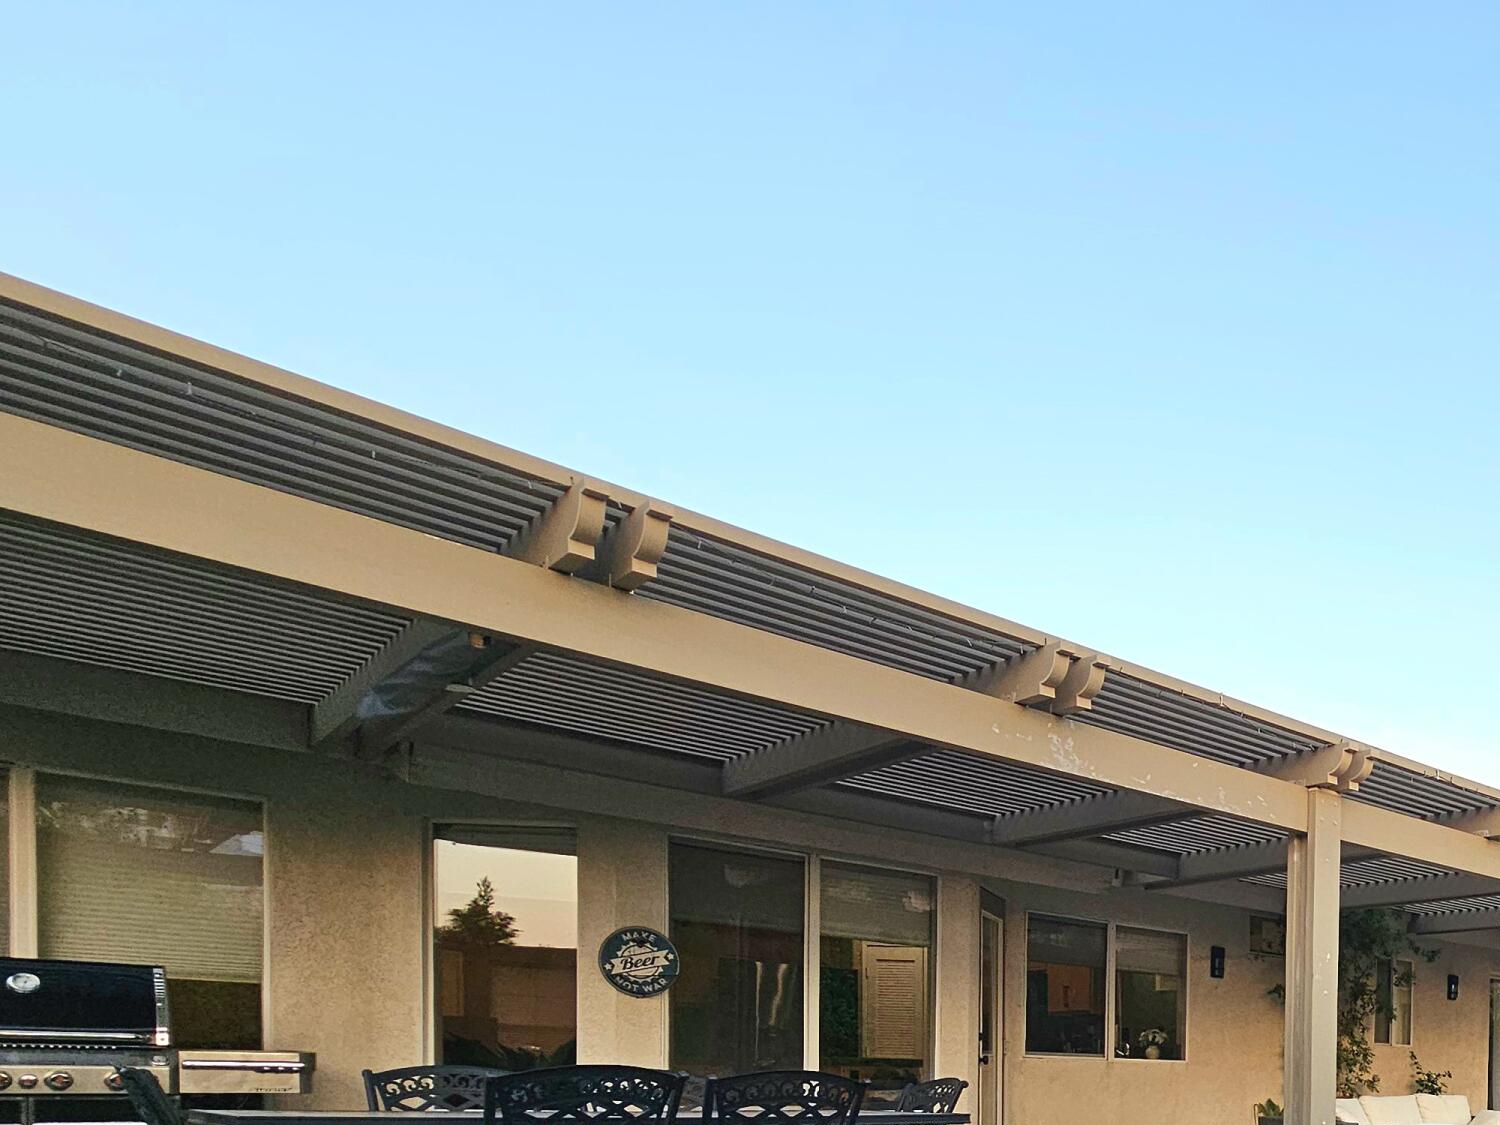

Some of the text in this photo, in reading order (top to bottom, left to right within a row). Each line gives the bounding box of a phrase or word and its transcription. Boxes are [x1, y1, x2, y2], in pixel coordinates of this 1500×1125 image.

[622, 931, 657, 942] MAKE
[620, 956, 660, 970] Beer
[615, 976, 668, 992] NOT WAR
